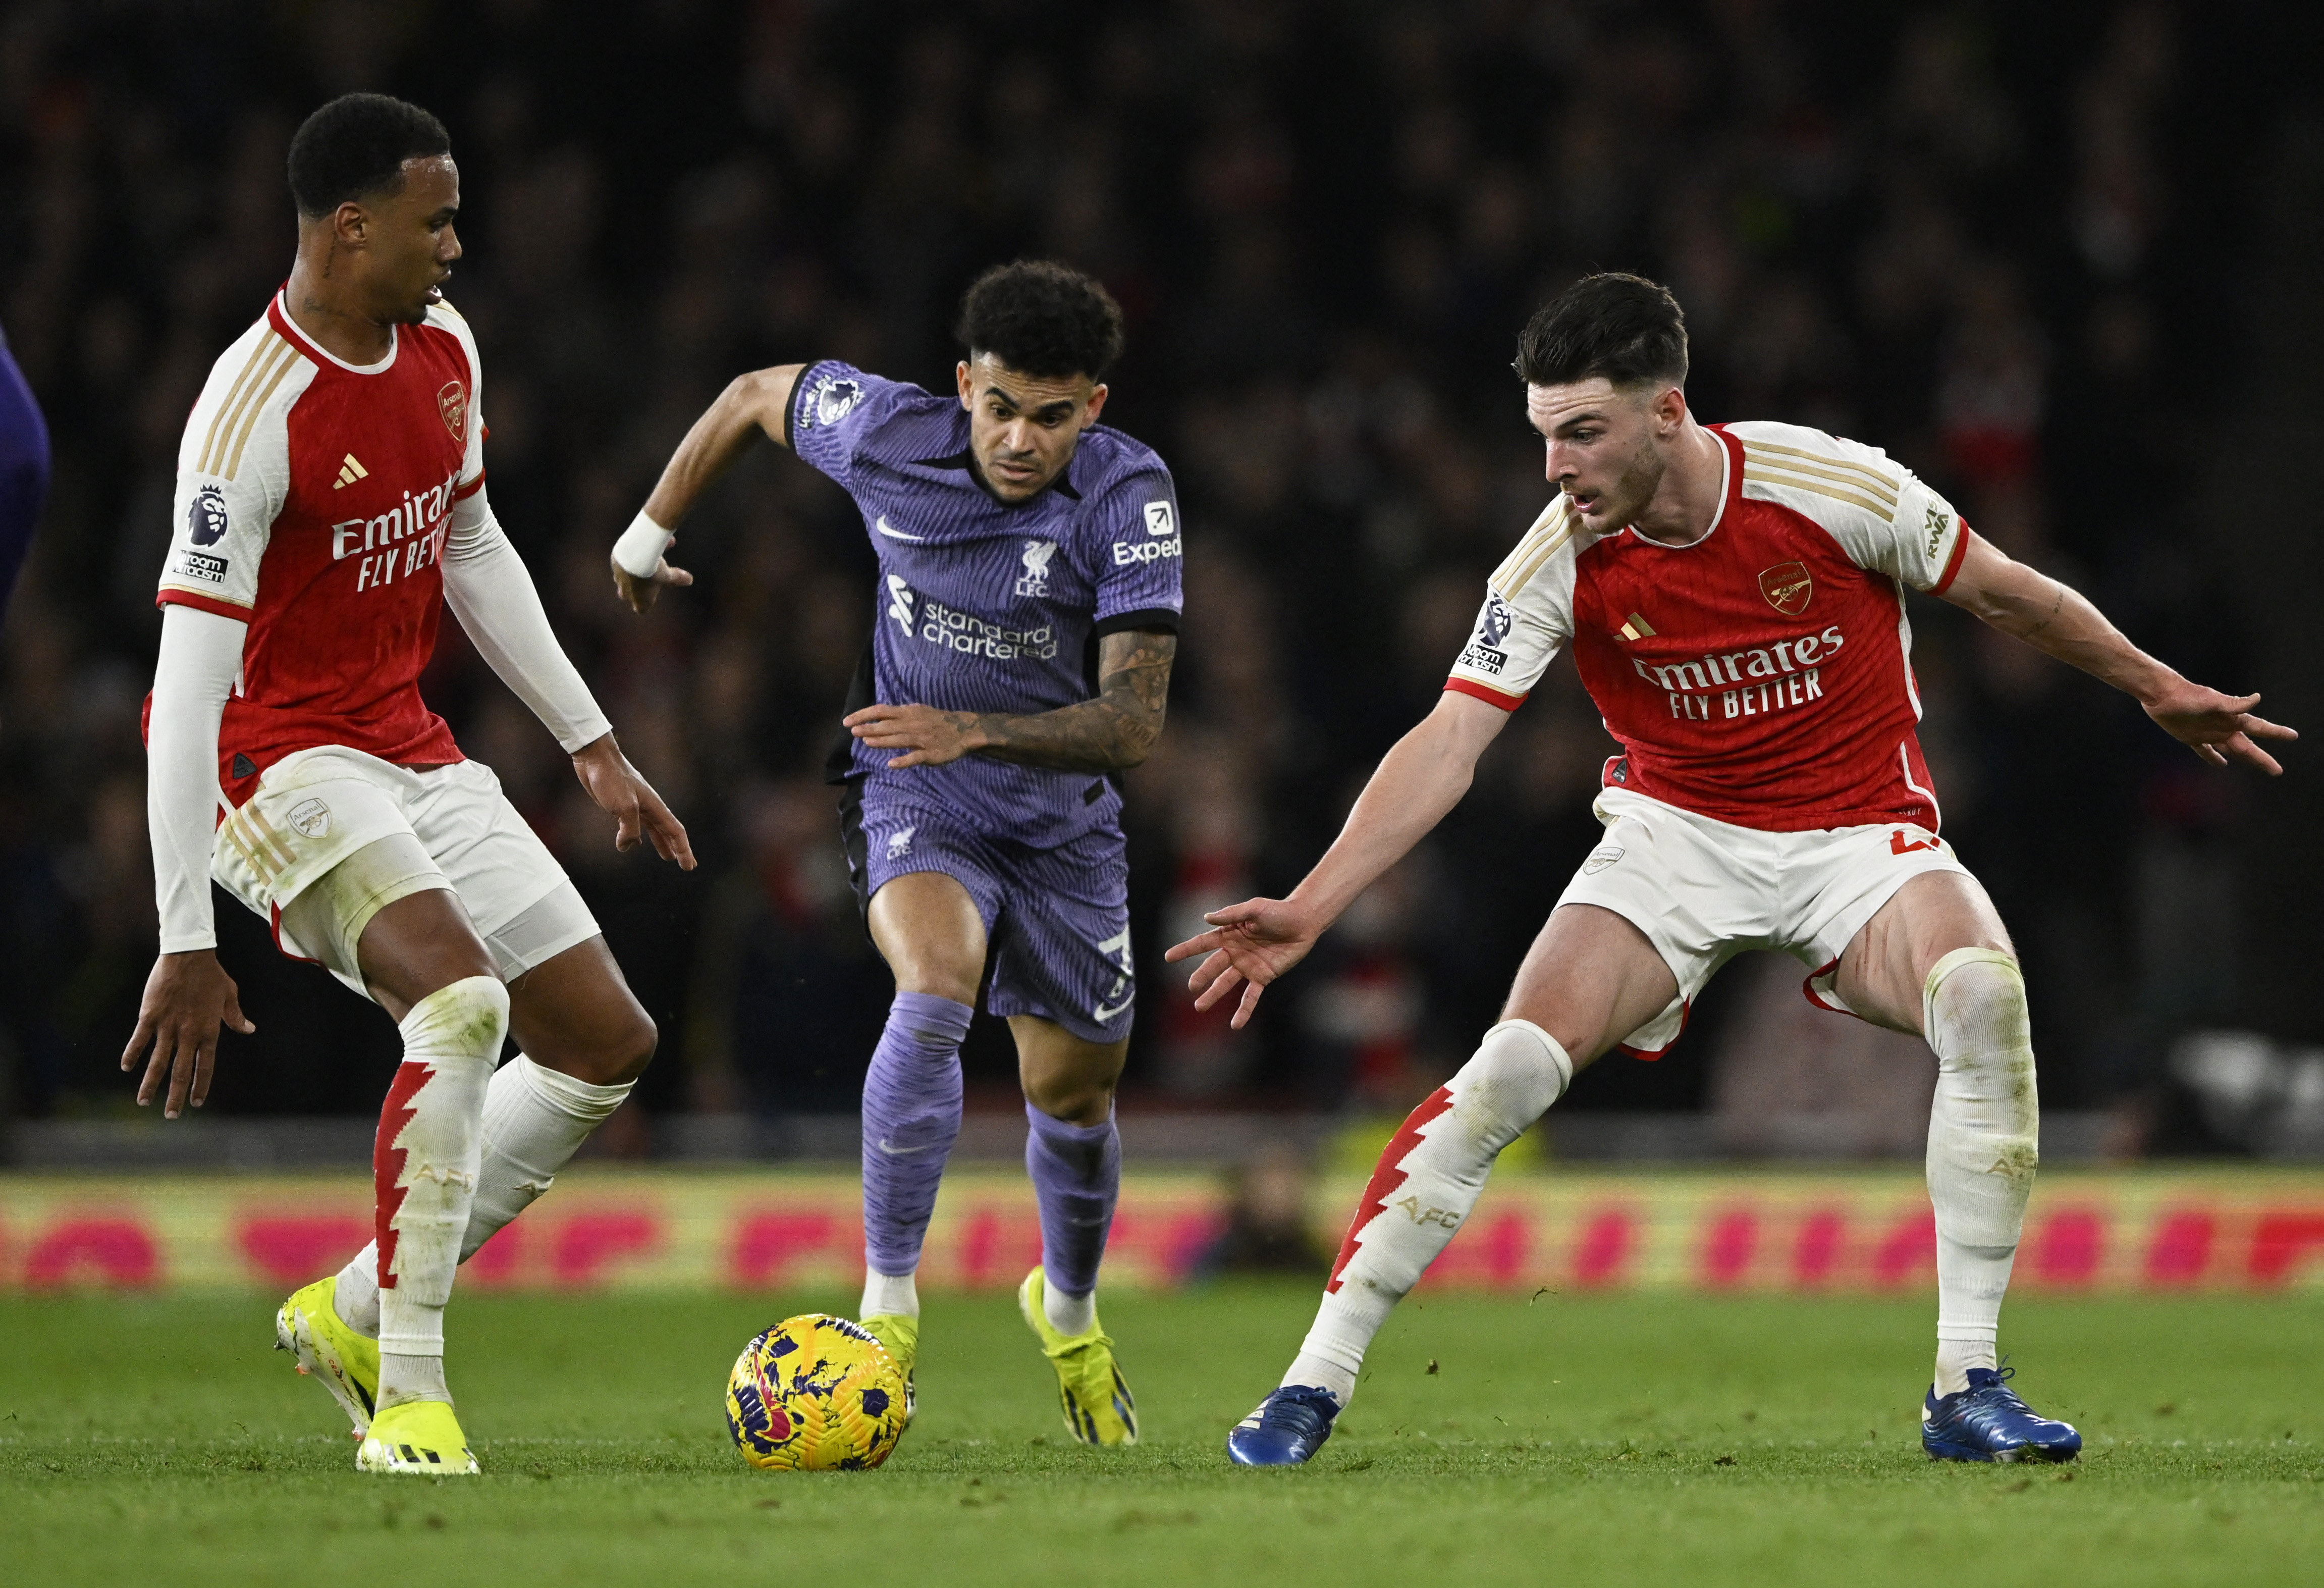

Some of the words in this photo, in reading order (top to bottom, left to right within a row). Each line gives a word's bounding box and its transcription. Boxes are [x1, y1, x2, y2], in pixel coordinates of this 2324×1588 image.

[444, 389, 462, 407] Arsenal
[332, 470, 461, 560] Emirat
[357, 548, 399, 592] FLY
[1767, 569, 1801, 585] Arsenal
[923, 623, 1057, 659] chartered
[1670, 693, 1709, 720] FLY
[1722, 668, 1823, 719] BETTER
[294, 803, 321, 820] Arsenal
[1396, 1196, 1460, 1229] AFC
